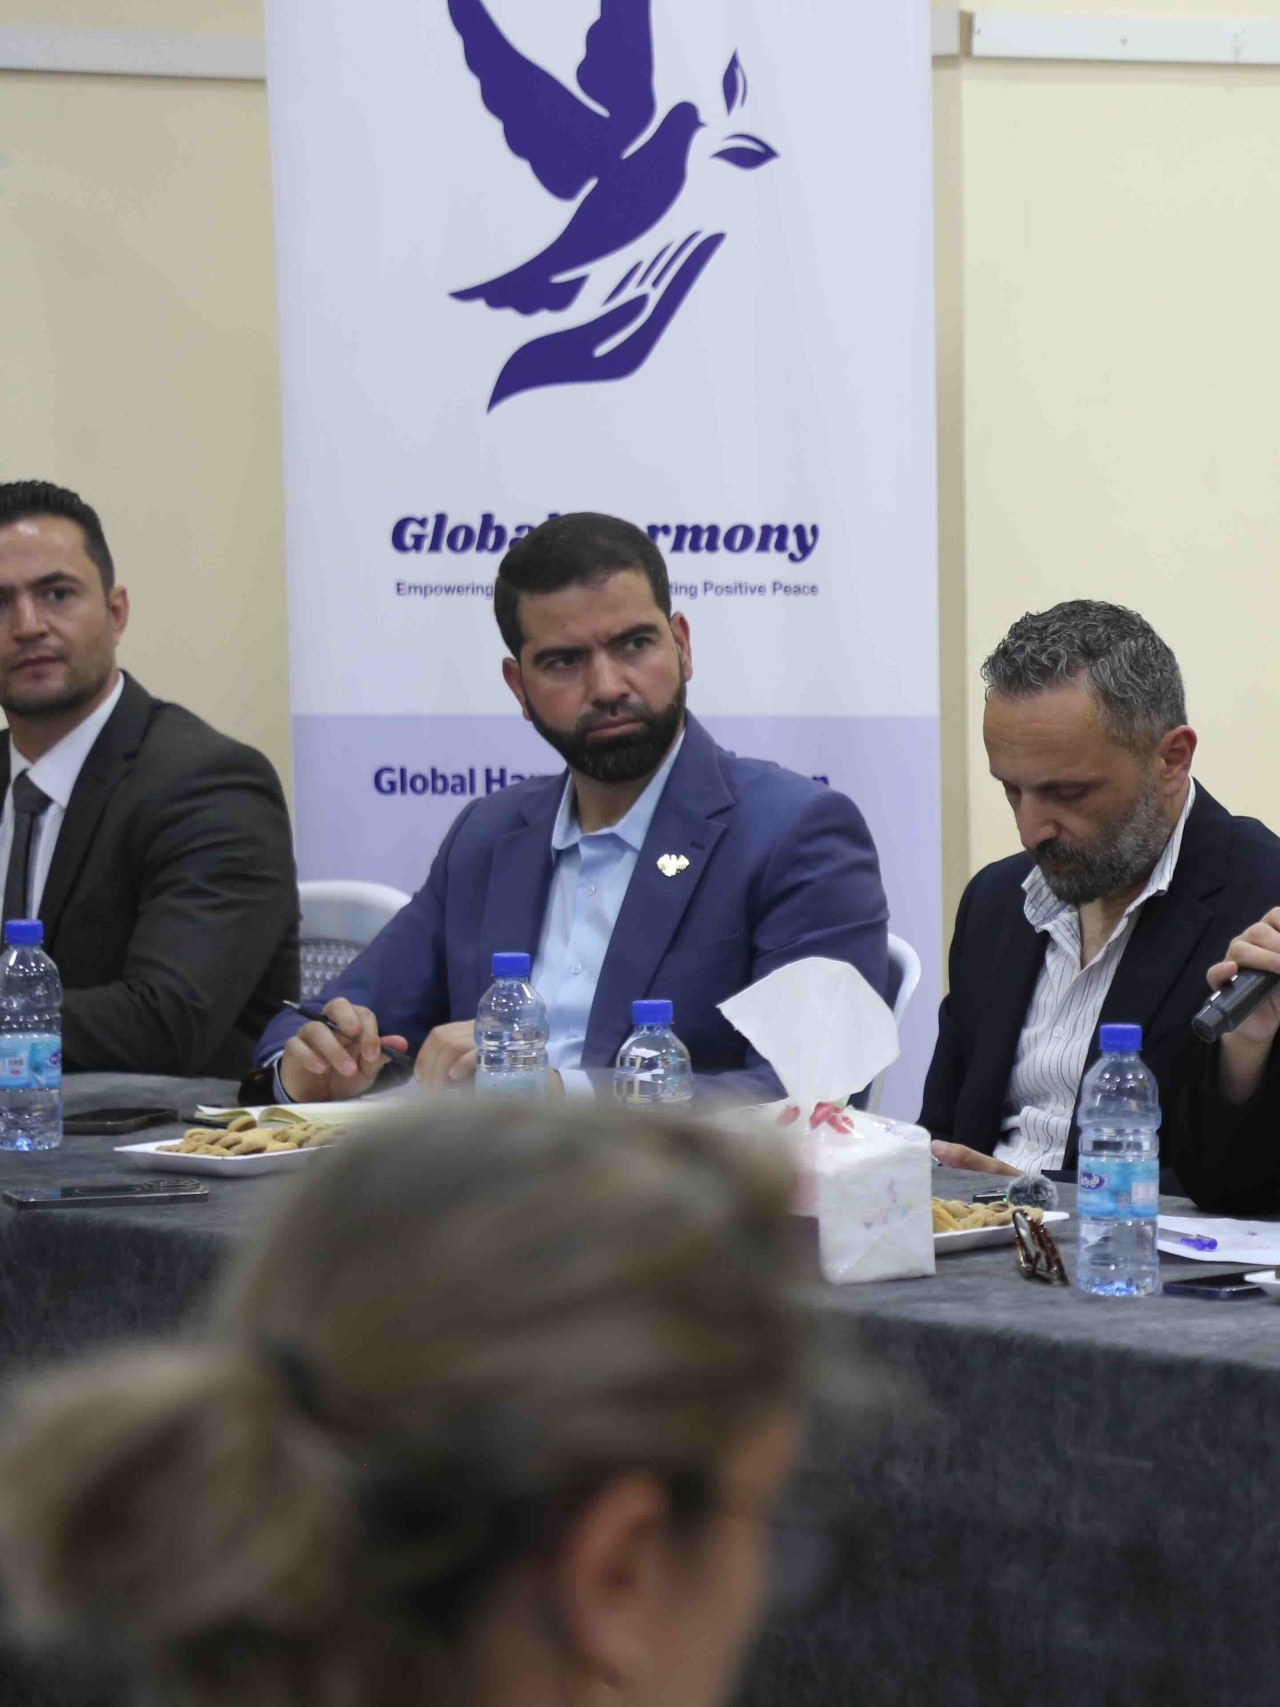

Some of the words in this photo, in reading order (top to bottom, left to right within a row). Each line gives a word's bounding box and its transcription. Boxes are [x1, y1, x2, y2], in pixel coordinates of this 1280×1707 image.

[391, 513, 561, 553] Globa
[647, 524, 820, 563] rmony
[396, 582, 495, 598] Empowering
[703, 581, 767, 596] Positive
[773, 581, 819, 596] Peace
[374, 767, 476, 795] Global
